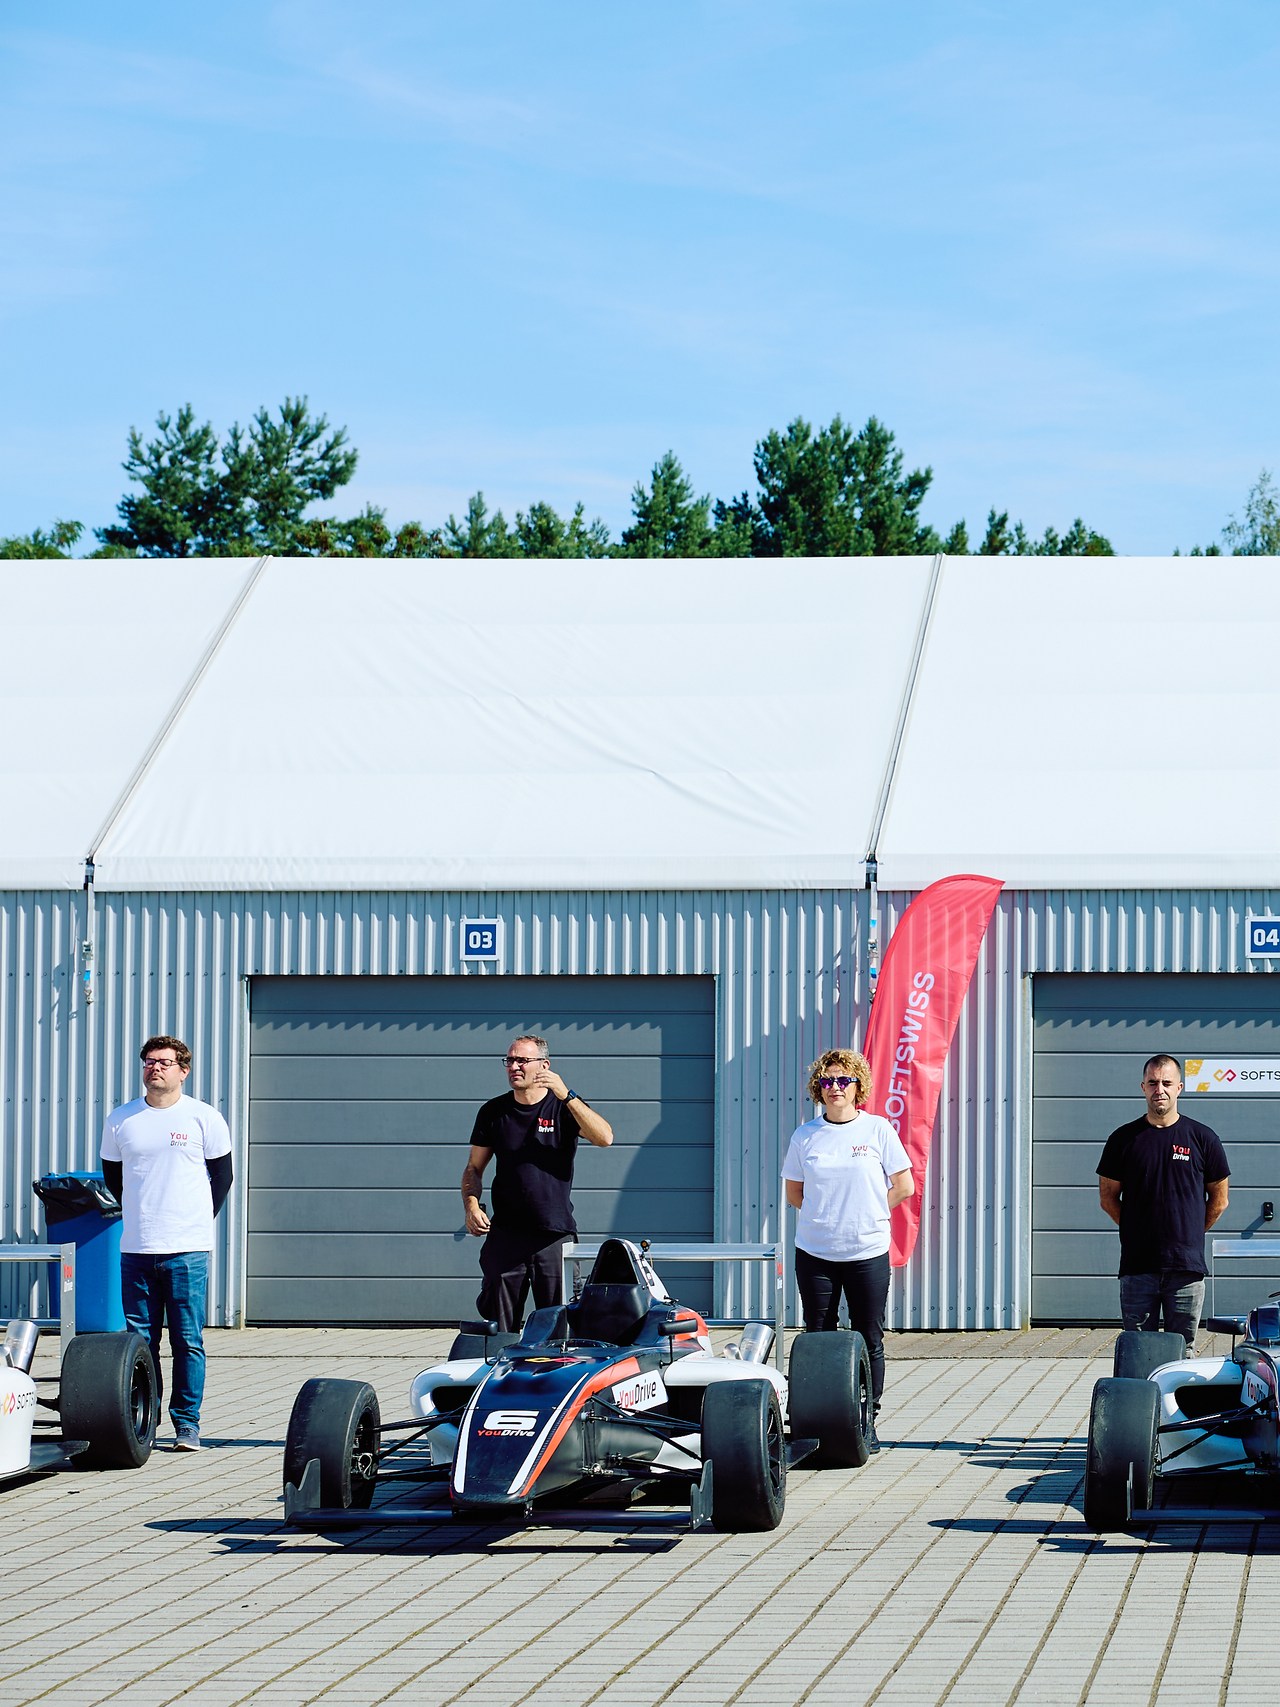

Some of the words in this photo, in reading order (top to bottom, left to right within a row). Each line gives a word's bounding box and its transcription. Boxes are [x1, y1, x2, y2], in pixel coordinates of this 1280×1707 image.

[468, 931, 493, 949] 03
[1253, 928, 1280, 947] 04
[170, 1132, 188, 1140] You
[1172, 1145, 1190, 1154] You
[1172, 1153, 1190, 1161] Drive
[619, 1379, 657, 1408] YouDrive
[483, 1410, 540, 1430] 6
[477, 1429, 536, 1437] YouDrive
